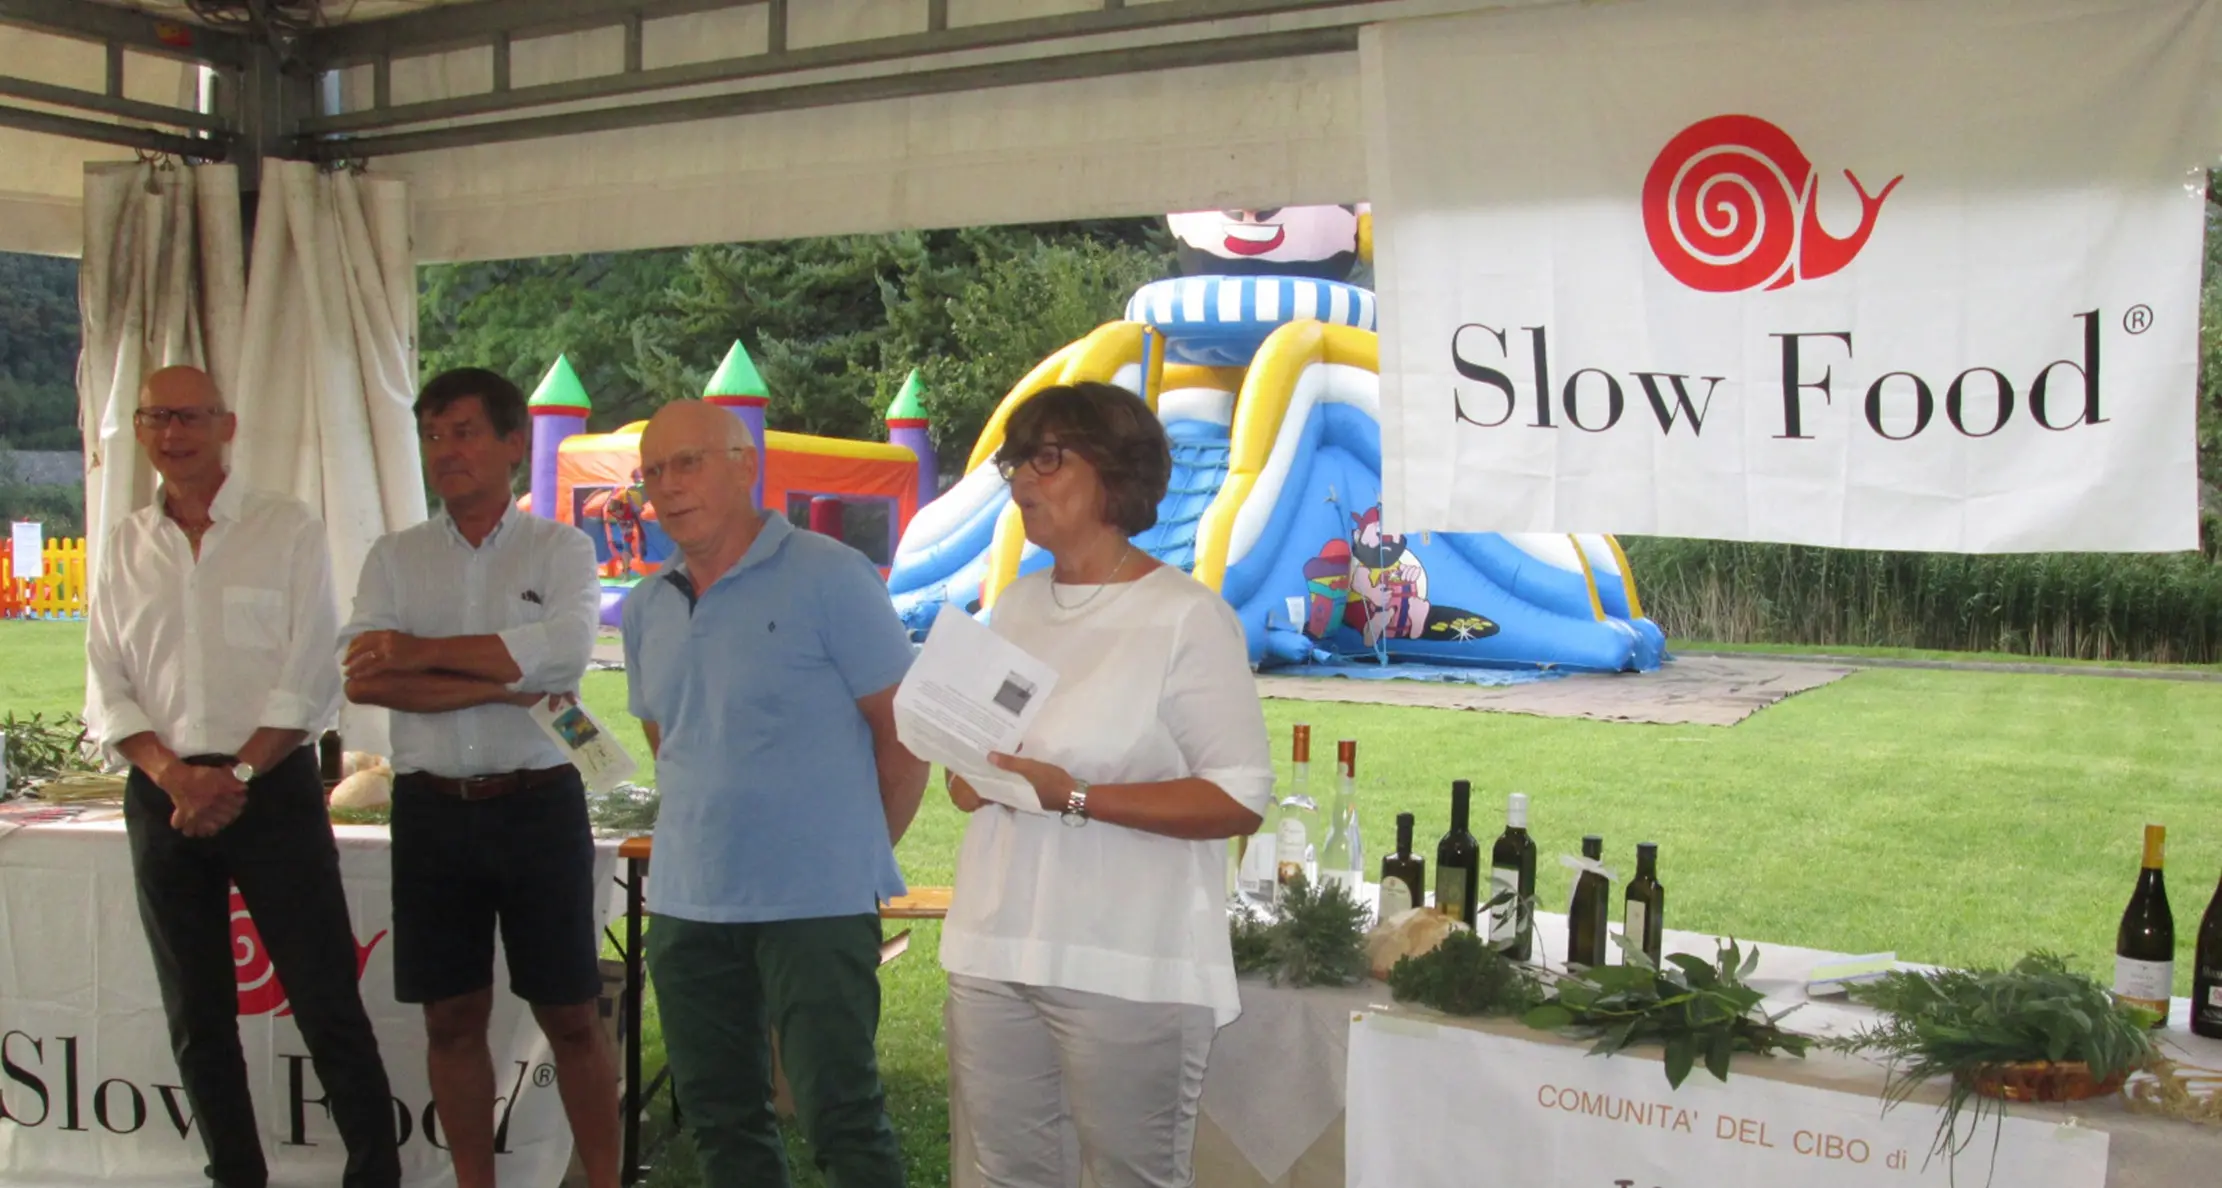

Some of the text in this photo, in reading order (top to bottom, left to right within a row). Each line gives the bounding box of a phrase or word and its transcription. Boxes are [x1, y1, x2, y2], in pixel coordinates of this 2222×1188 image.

[1451, 322, 1726, 437] Slow
[1768, 308, 2112, 441] Food
[1537, 1083, 1908, 1171] COMUNITA' DEL CIBO di
